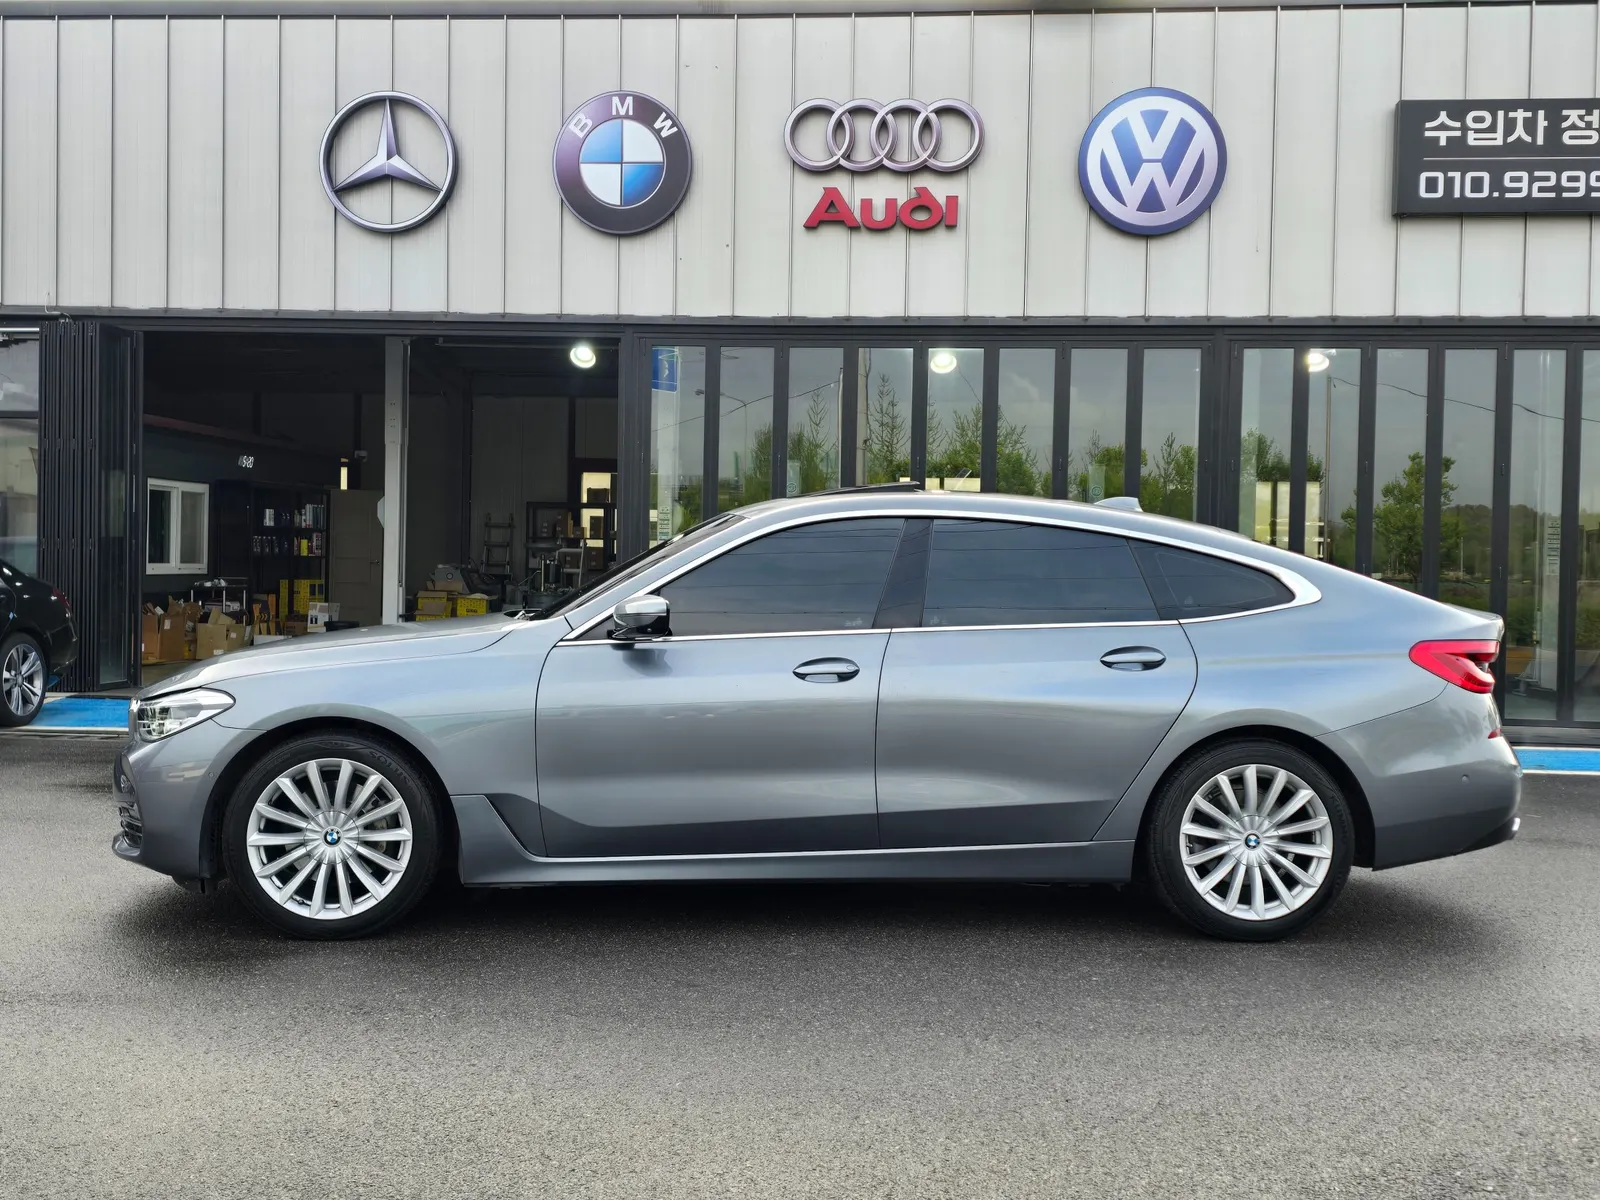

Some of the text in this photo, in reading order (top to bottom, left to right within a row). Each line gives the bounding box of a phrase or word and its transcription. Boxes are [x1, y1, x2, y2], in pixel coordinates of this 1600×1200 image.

[568, 95, 678, 140] BMW
[1424, 108, 1600, 146] 수입차 정
[802, 186, 959, 231] Audi
